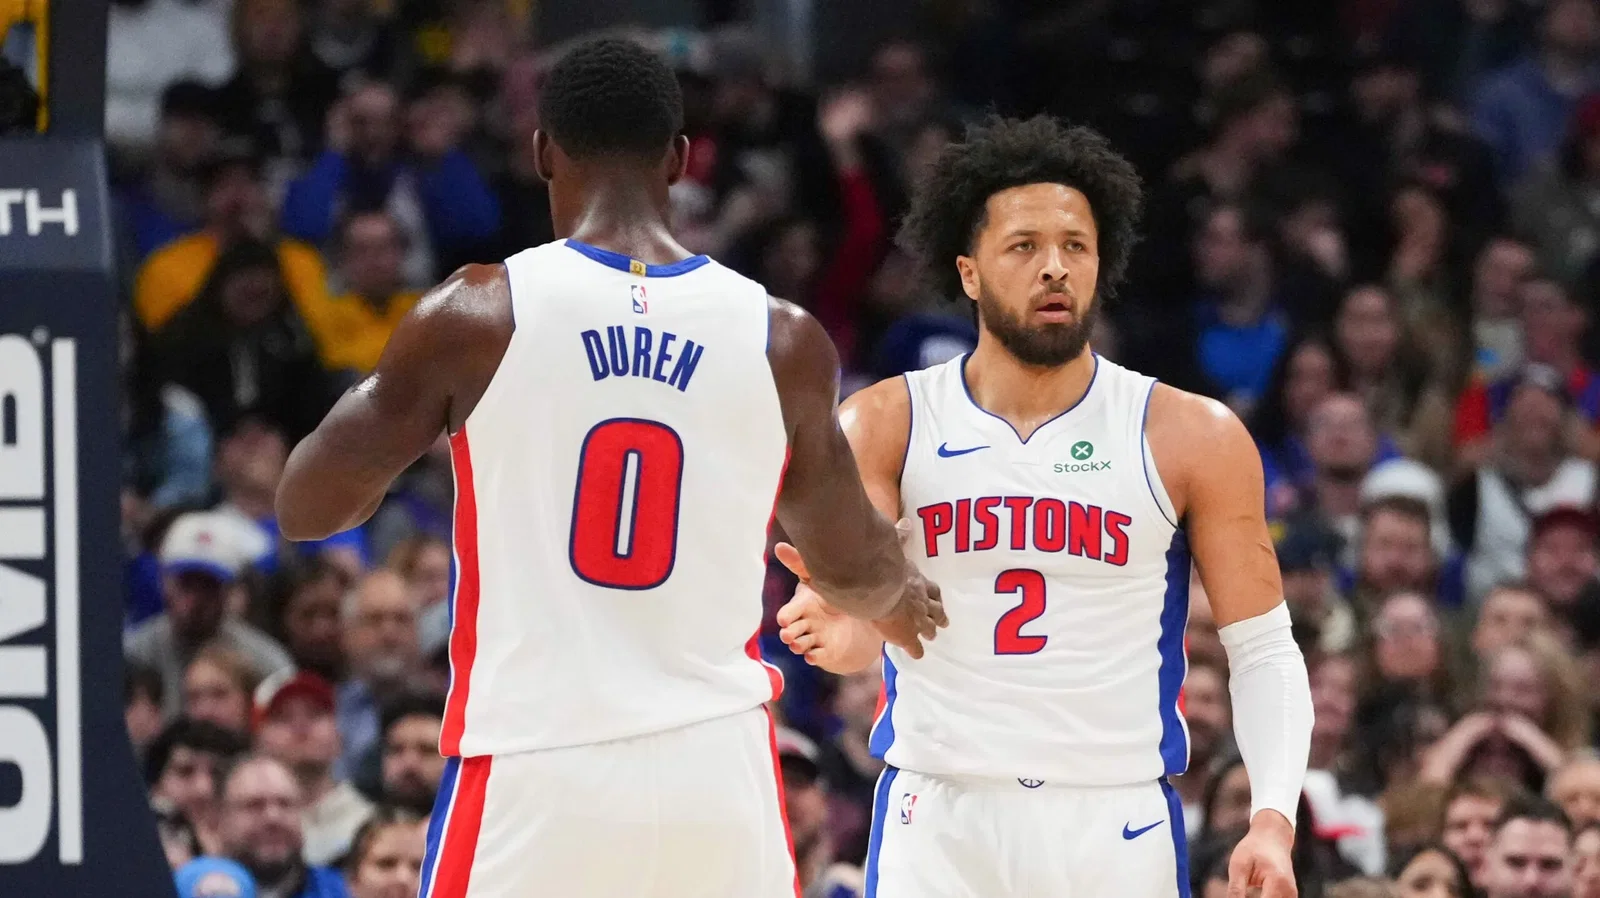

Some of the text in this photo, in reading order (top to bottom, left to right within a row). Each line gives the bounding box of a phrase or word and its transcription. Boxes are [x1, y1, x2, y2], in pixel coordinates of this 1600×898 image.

[580, 325, 704, 392] DUREN
[1053, 460, 1112, 473] StockX
[568, 417, 684, 590] 0
[917, 496, 1132, 567] PISTONS
[994, 568, 1048, 655] 2
